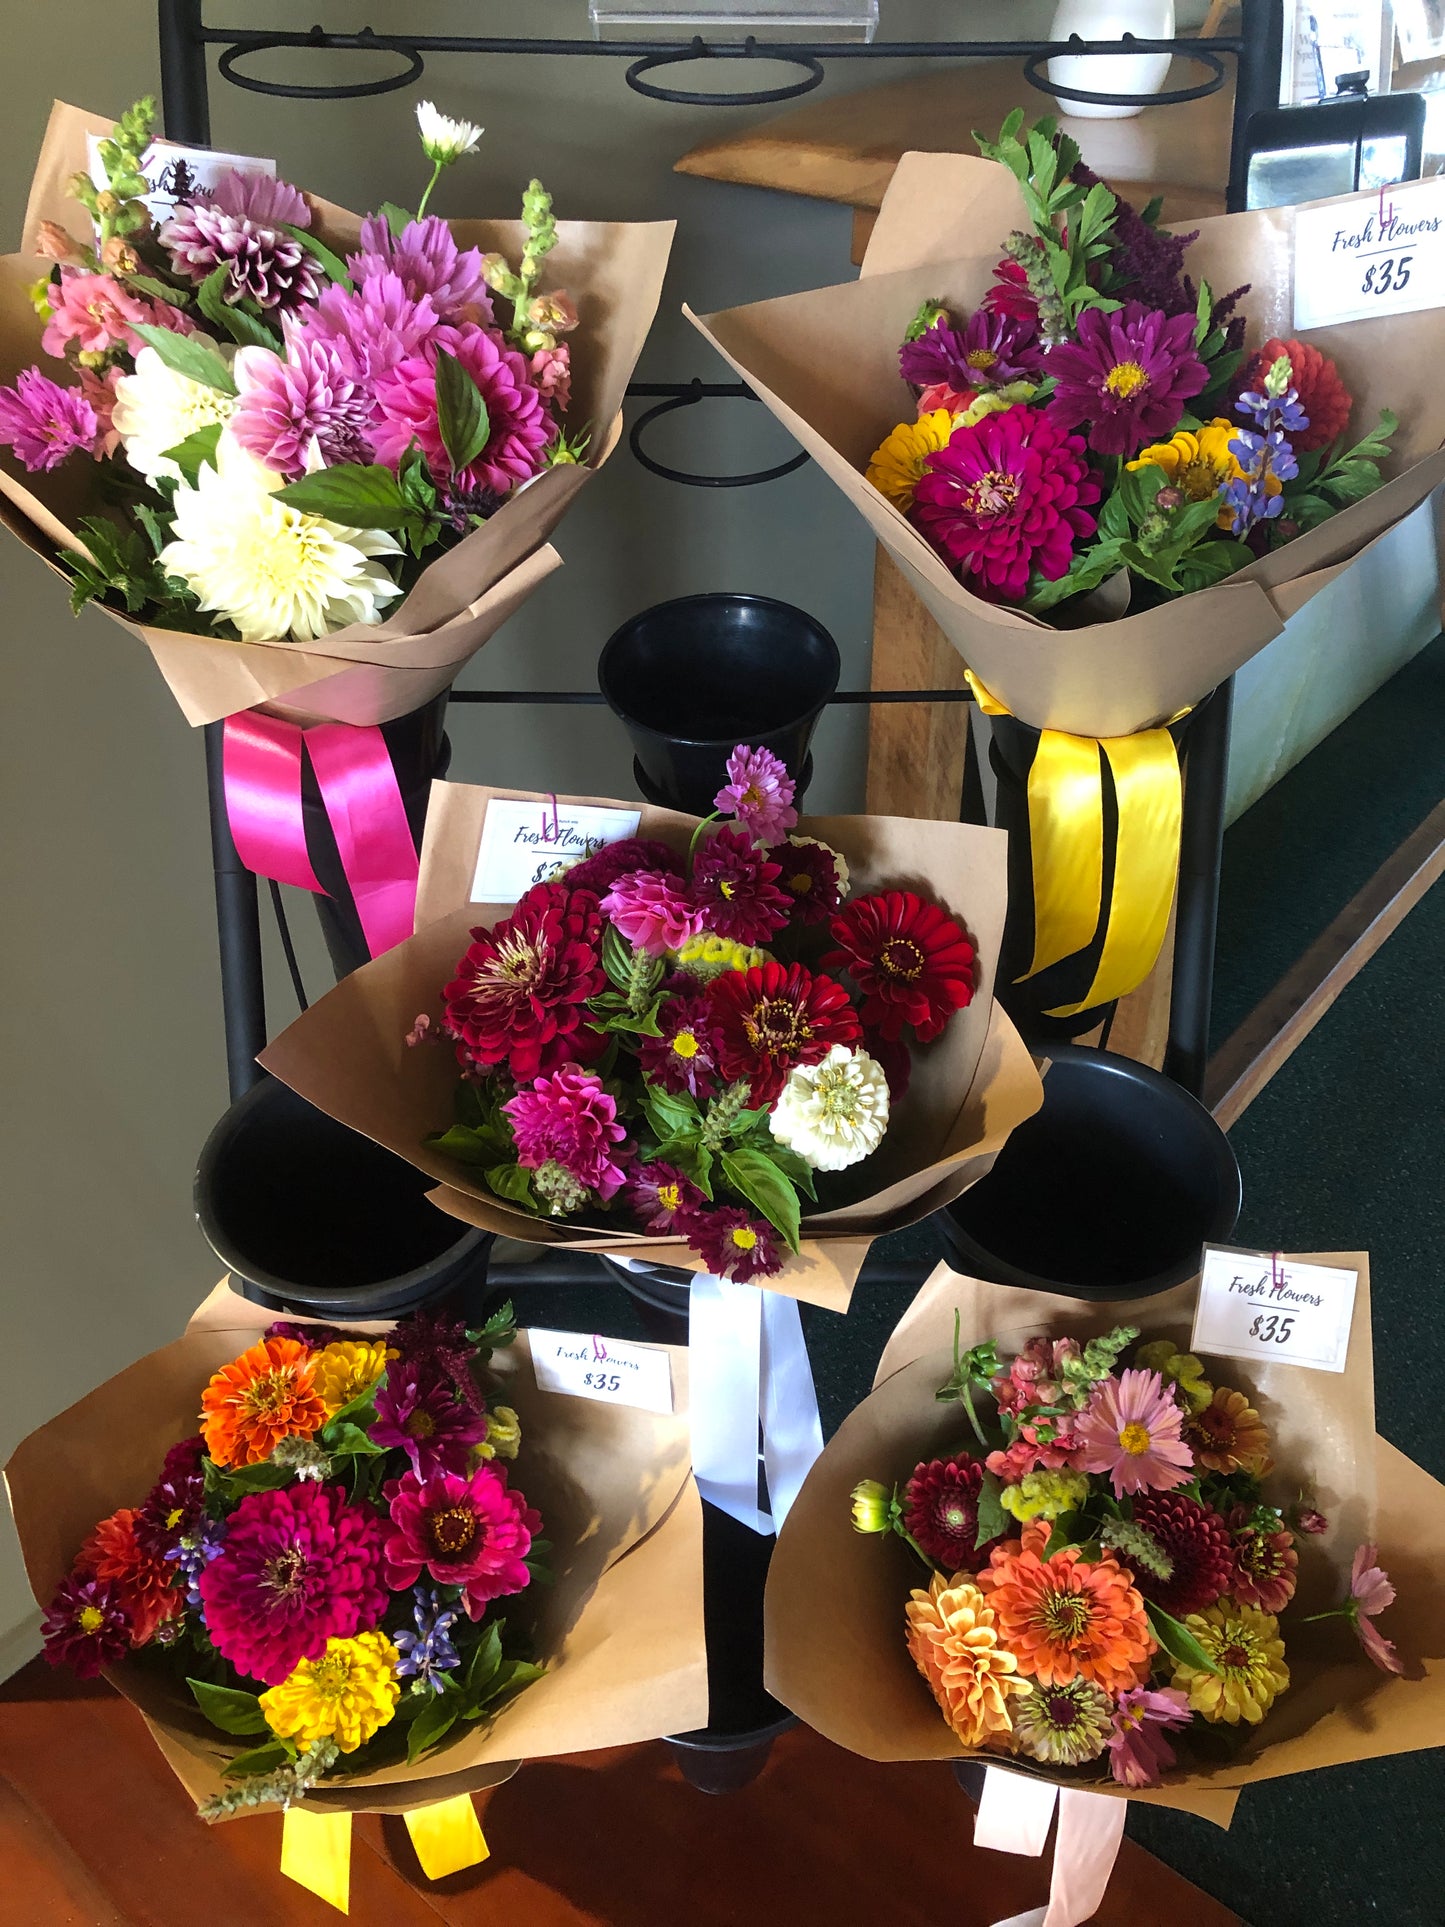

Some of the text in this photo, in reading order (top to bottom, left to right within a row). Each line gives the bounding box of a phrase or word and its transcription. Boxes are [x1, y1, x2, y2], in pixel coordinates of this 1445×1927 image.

[1331, 216, 1442, 252] Fresh Flowers
[1361, 256, 1413, 295] $35
[513, 822, 608, 849] Fresh Flowers
[1228, 1275, 1325, 1306] Fresh Flowers
[1249, 1314, 1295, 1343] $35
[556, 1346, 587, 1361] Fresh
[583, 1372, 622, 1391] $35
